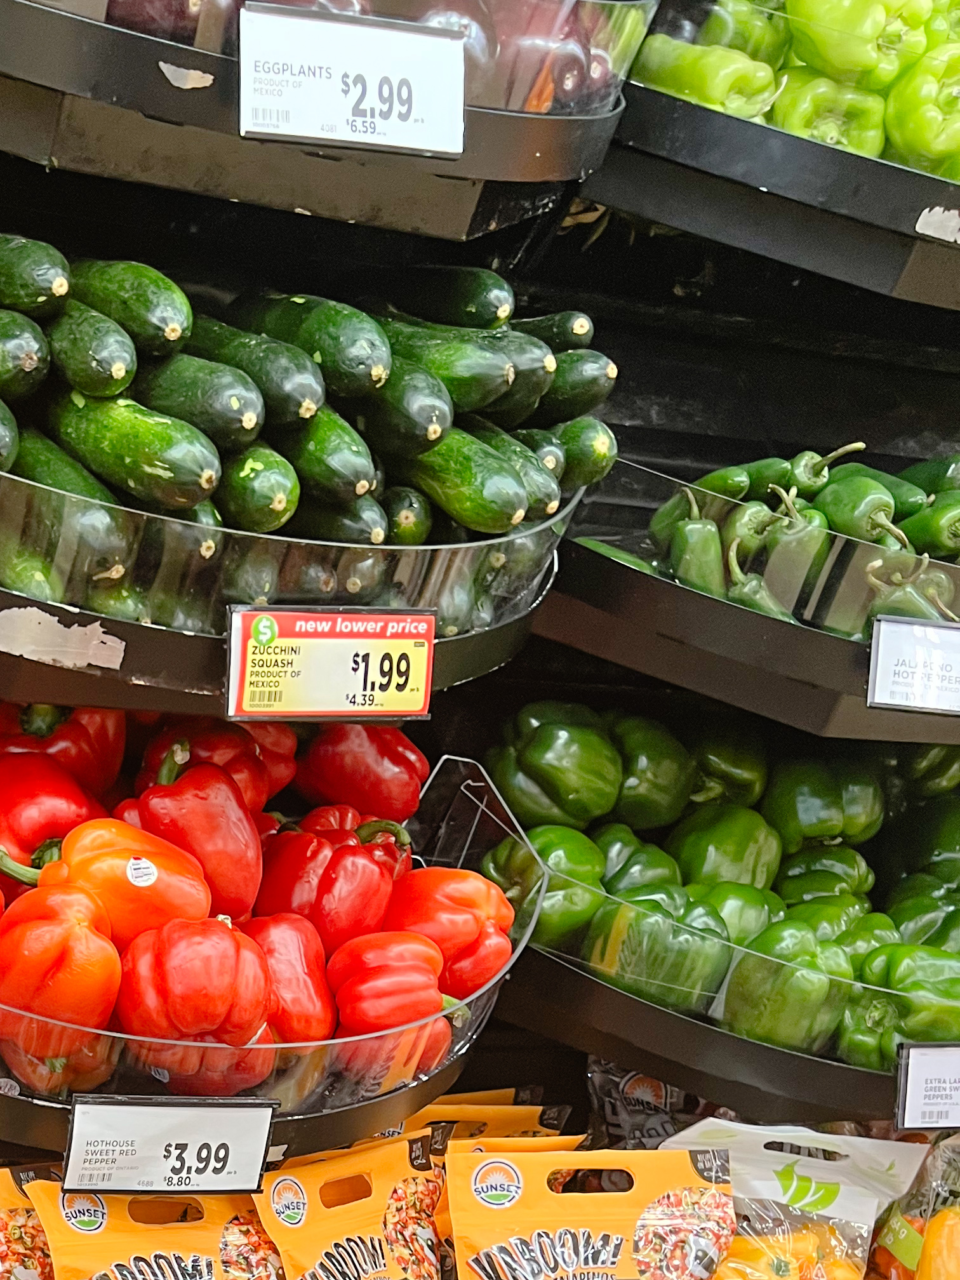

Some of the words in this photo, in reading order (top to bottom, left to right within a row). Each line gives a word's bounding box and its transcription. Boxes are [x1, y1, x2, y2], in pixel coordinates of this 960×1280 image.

[253, 60, 332, 80] EGGPLANTS
[253, 78, 290, 89] PRODUCT
[292, 81, 303, 89] OF
[253, 87, 283, 97] MEXICO
[341, 71, 413, 122] $2.99
[320, 123, 338, 134] 4081
[346, 119, 377, 135] $6.59
[295, 619, 332, 633] new
[336, 617, 384, 633] lower
[386, 618, 428, 636] price
[251, 645, 301, 656] ZUCCHINI
[250, 658, 293, 669] SQUASH
[250, 670, 288, 679] PRODUCT
[290, 670, 302, 678] OF
[351, 651, 411, 693] $1.99
[893, 669, 917, 680] HOT
[248, 680, 280, 689] MEXICO
[345, 693, 375, 708] $4.39
[924, 1077, 947, 1085] EXTRA
[924, 1085, 947, 1093] GREEN
[923, 1093, 953, 1101] PEPPERS
[86, 1139, 136, 1148] HOTHOUSE
[84, 1148, 117, 1157] SWEET
[118, 1148, 137, 1157] RED
[83, 1157, 117, 1165] PEPPER
[162, 1142, 230, 1176] $3.99
[136, 1180, 154, 1188] 4688
[163, 1175, 191, 1187] $8.80
[64, 1208, 107, 1222] SUNSET
[276, 1201, 307, 1218] SUNSET
